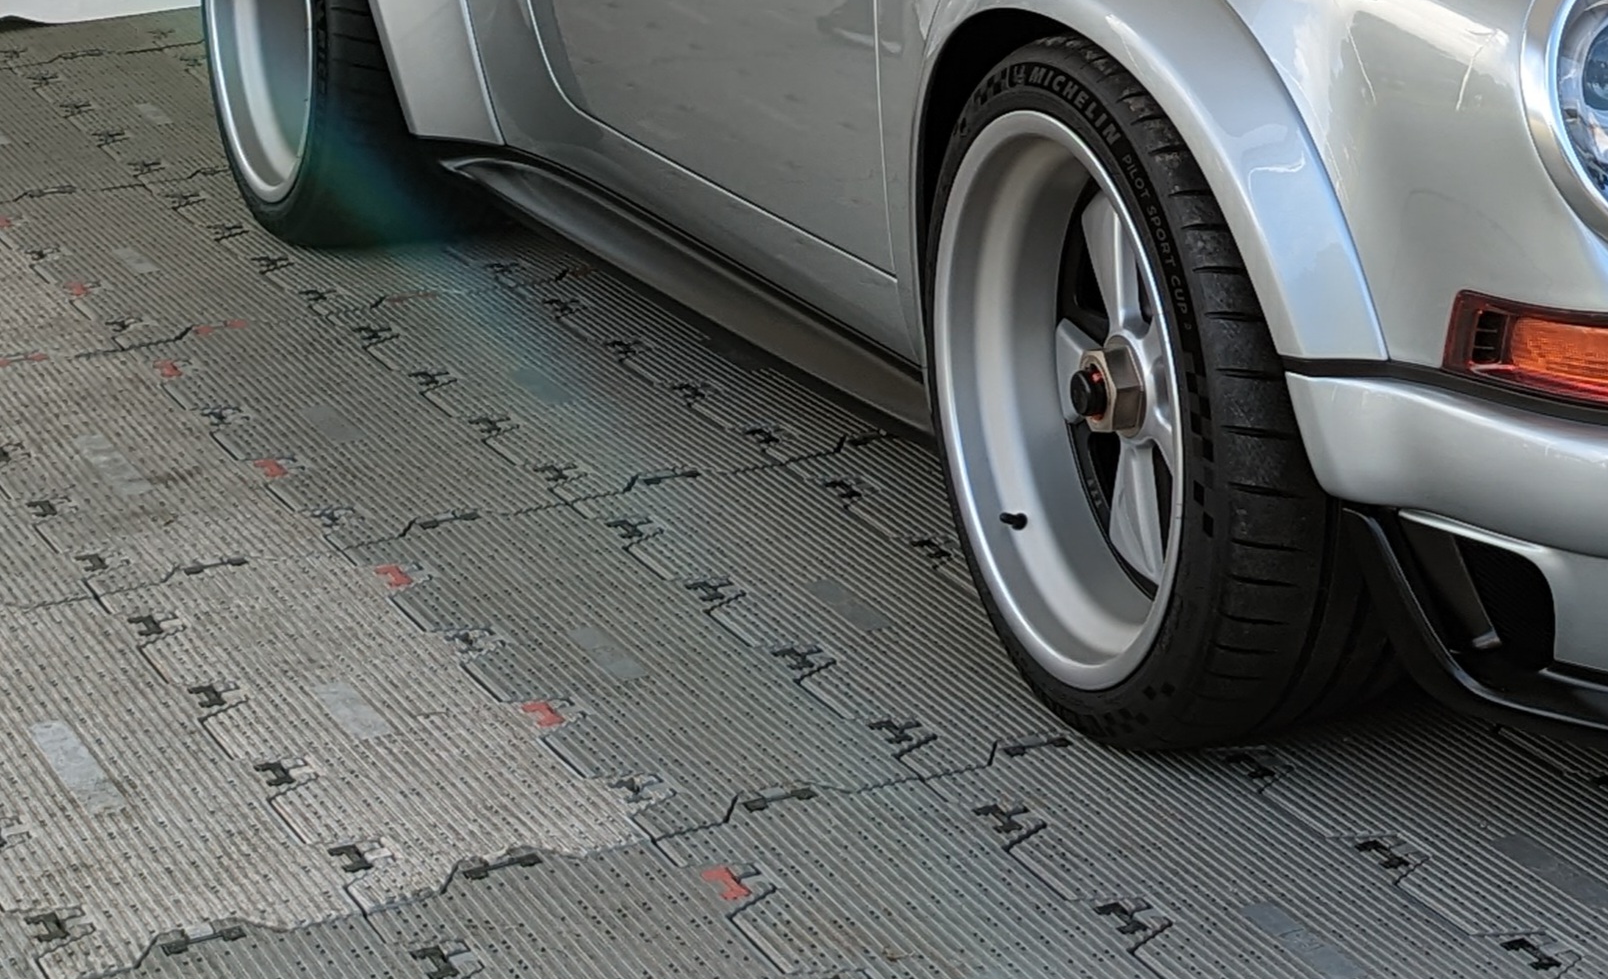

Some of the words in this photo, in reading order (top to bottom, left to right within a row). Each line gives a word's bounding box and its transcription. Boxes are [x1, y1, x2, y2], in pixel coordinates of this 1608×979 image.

[1027, 66, 1122, 146] MICHELIN
[1121, 154, 1150, 198] PILOT
[1146, 205, 1177, 268] SPORT
[1170, 275, 1188, 315] CUP
